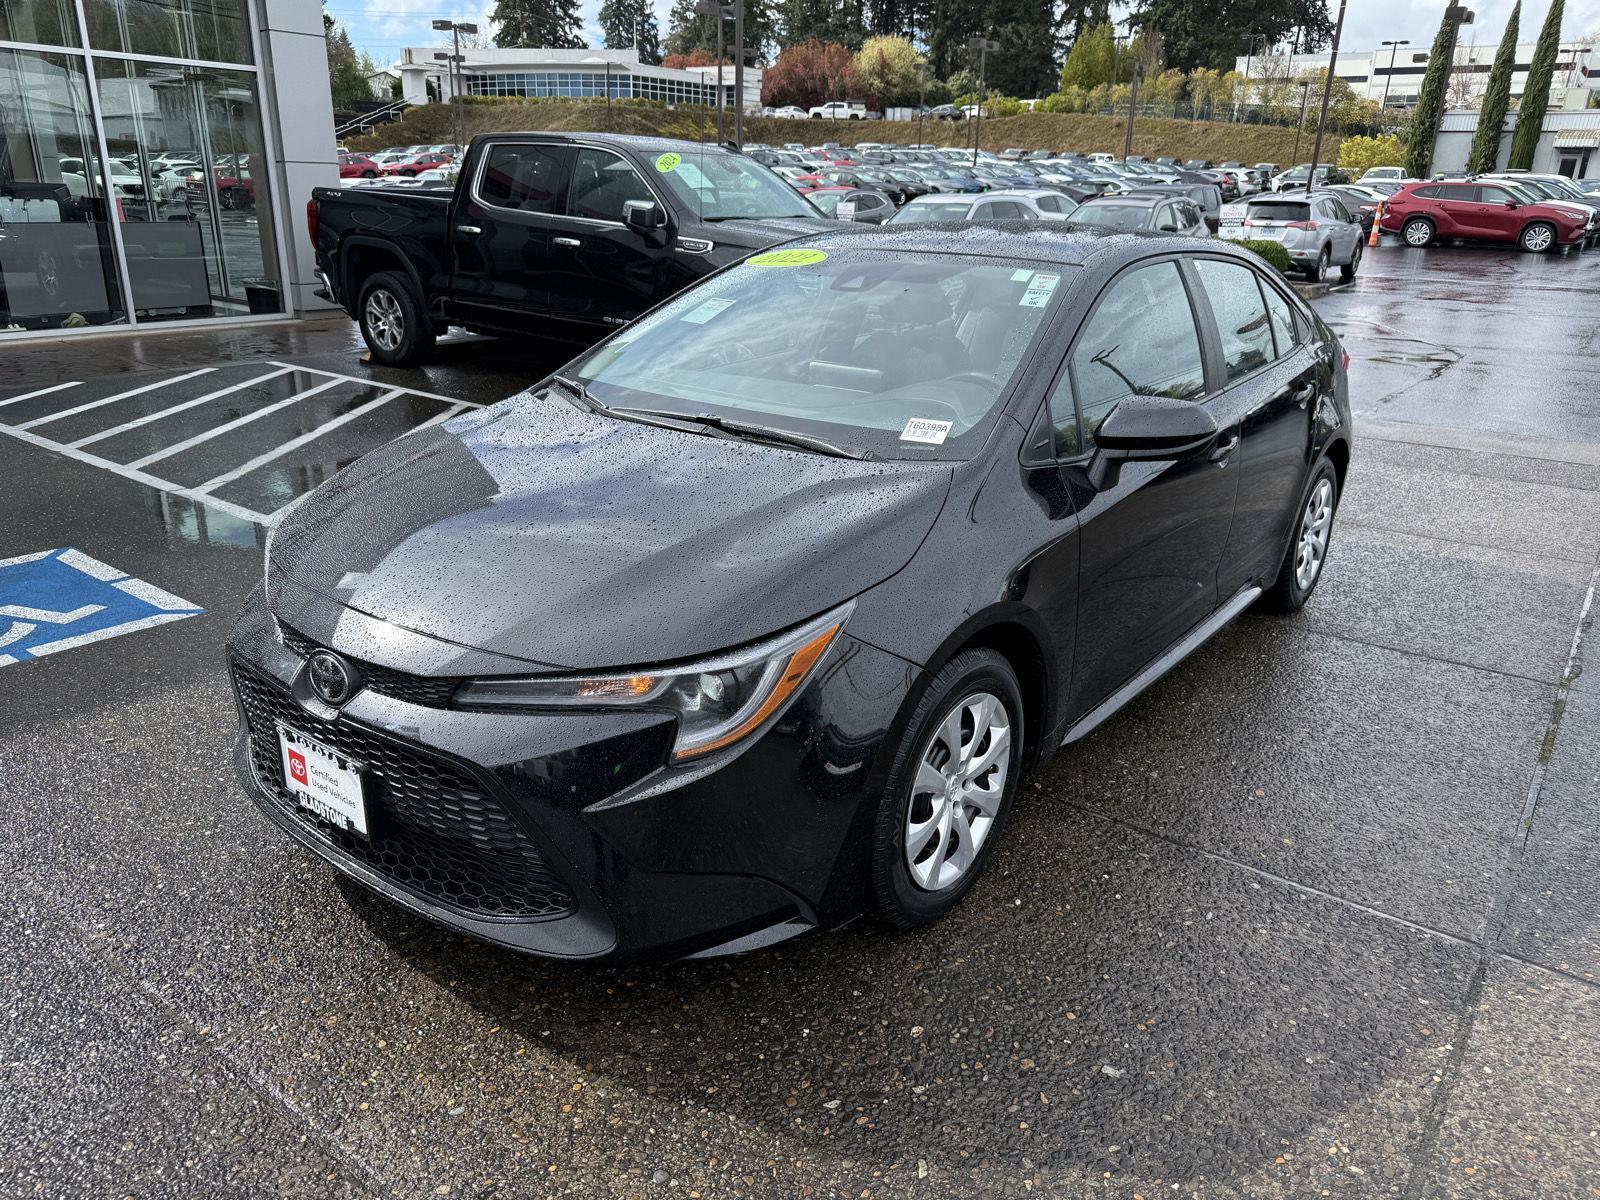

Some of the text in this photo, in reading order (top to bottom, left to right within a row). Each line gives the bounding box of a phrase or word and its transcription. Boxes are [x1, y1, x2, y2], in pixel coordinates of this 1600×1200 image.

[908, 420, 948, 433] T60398A
[310, 765, 339, 787] Certified
[312, 779, 356, 809] Used Vehicles
[298, 792, 349, 830] GLADSTONE
